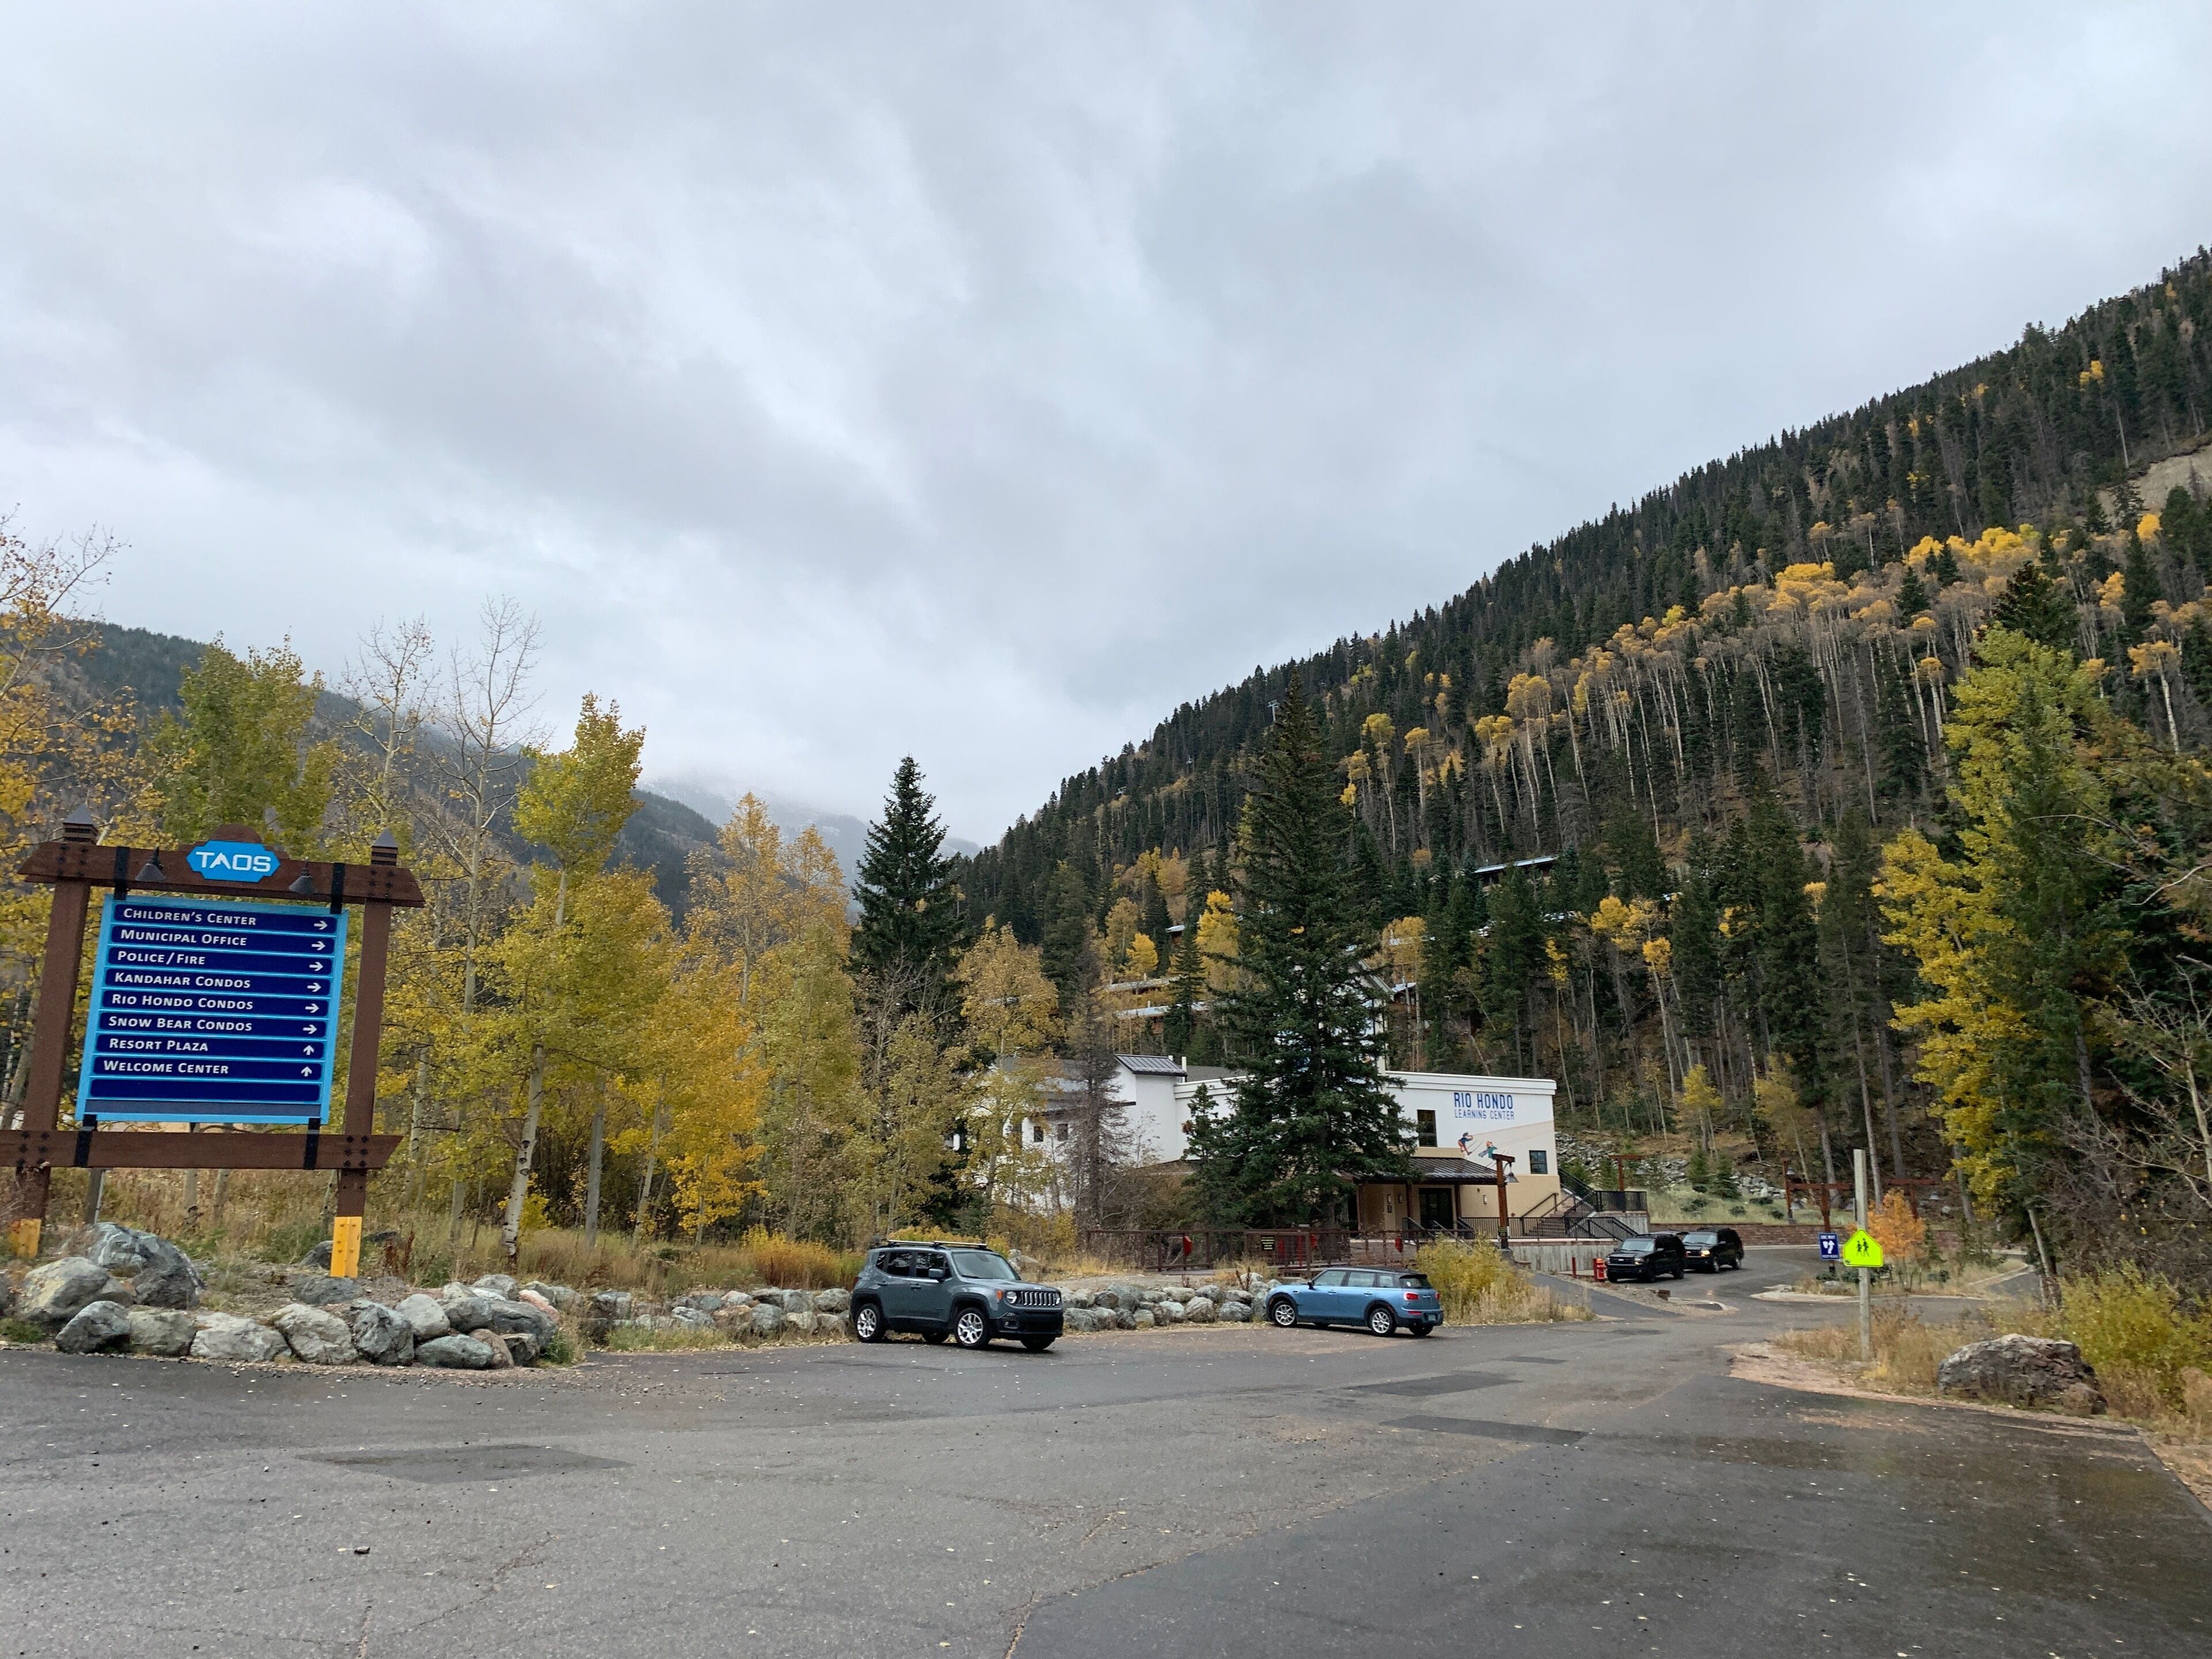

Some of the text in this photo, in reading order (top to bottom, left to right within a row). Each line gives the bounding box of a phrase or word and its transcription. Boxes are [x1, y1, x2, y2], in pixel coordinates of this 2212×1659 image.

[195, 851, 271, 872] TAOS
[207, 913, 256, 926] CENTER
[120, 929, 247, 946] MUNICIPAL OFFICE
[115, 972, 251, 988] KANDAHAR CONDOS
[111, 994, 253, 1010] RIO HONDO CONDOS
[108, 1016, 252, 1031] SNOW BEAR CONDOS
[109, 1038, 209, 1052] RESORT PLAZA
[103, 1060, 229, 1074] WELCOME CENTER
[1454, 1092, 1513, 1109] RIO HONDO
[1455, 1109, 1514, 1120] LEARNING CENTER
